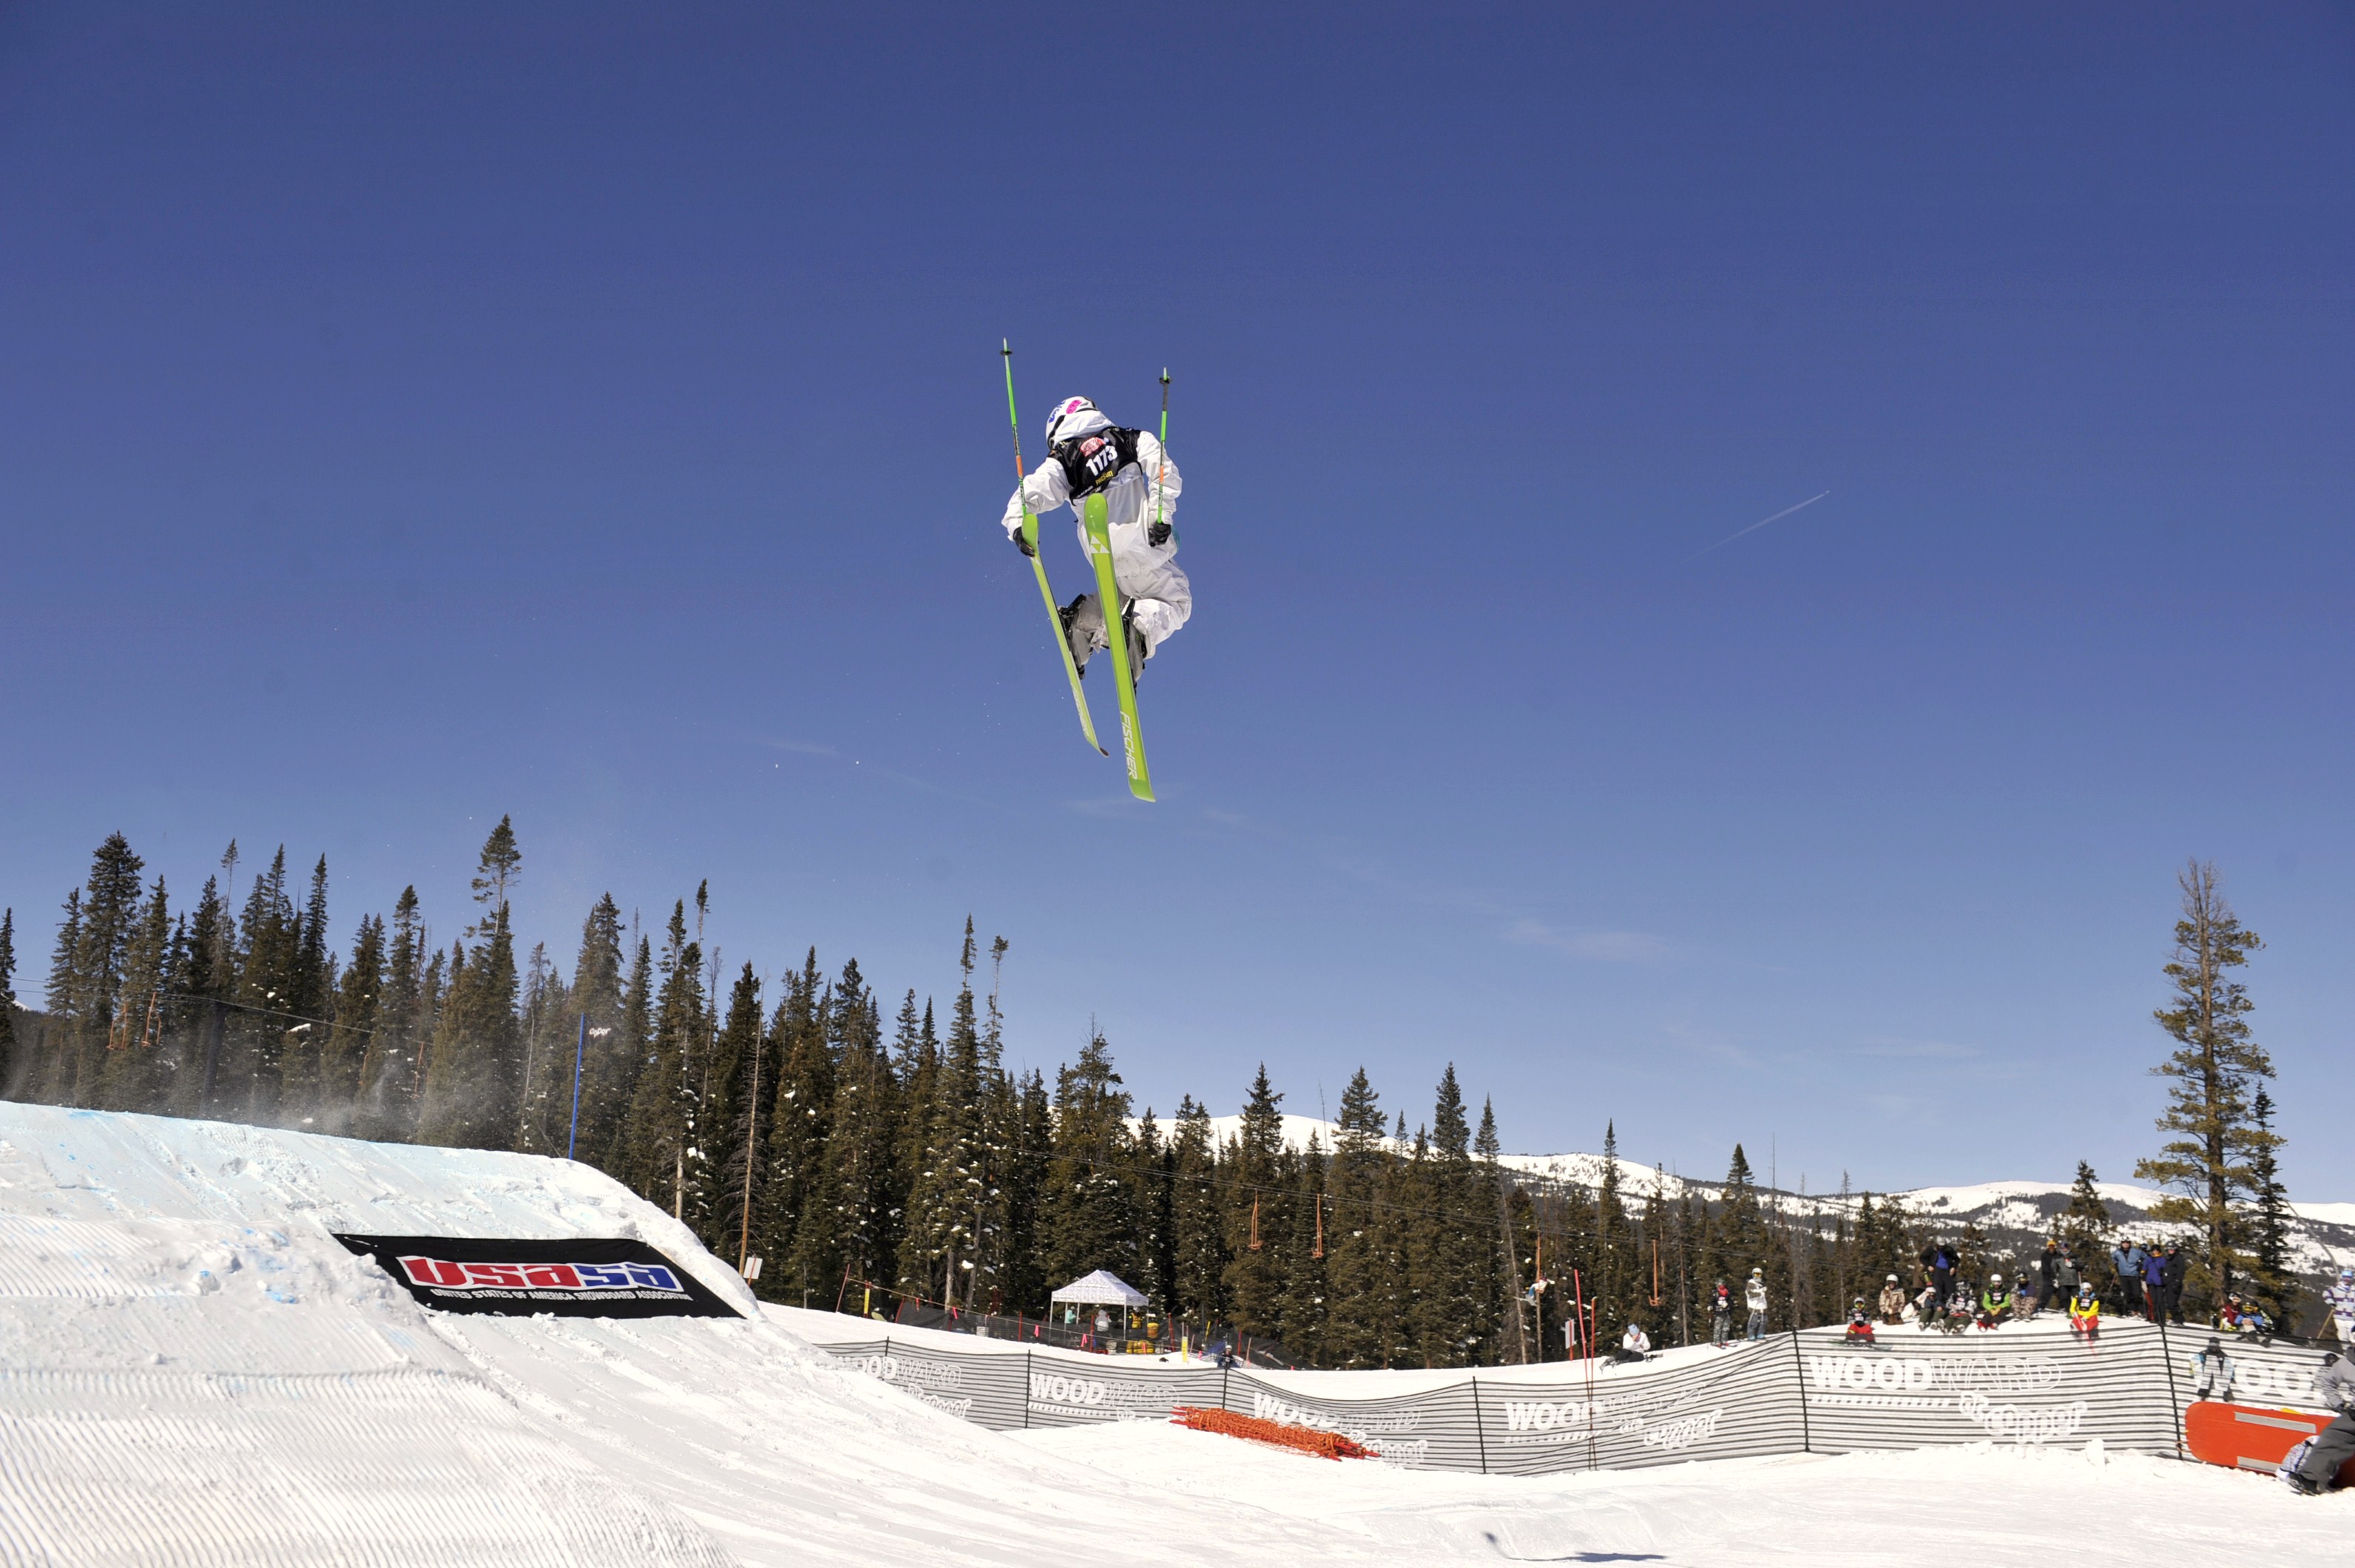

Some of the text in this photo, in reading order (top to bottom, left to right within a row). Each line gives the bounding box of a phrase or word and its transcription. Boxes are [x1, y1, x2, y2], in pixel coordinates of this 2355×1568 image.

[1086, 445, 1118, 477] 1173
[1120, 711, 1138, 780] FISCHER
[430, 1288, 473, 1300] UNITED
[471, 1289, 513, 1299] STATES
[513, 1291, 528, 1300] OF
[528, 1291, 576, 1301] AMERICA
[576, 1291, 636, 1301] SNOWBOARD
[1808, 1356, 2062, 1391] WOODWARD
